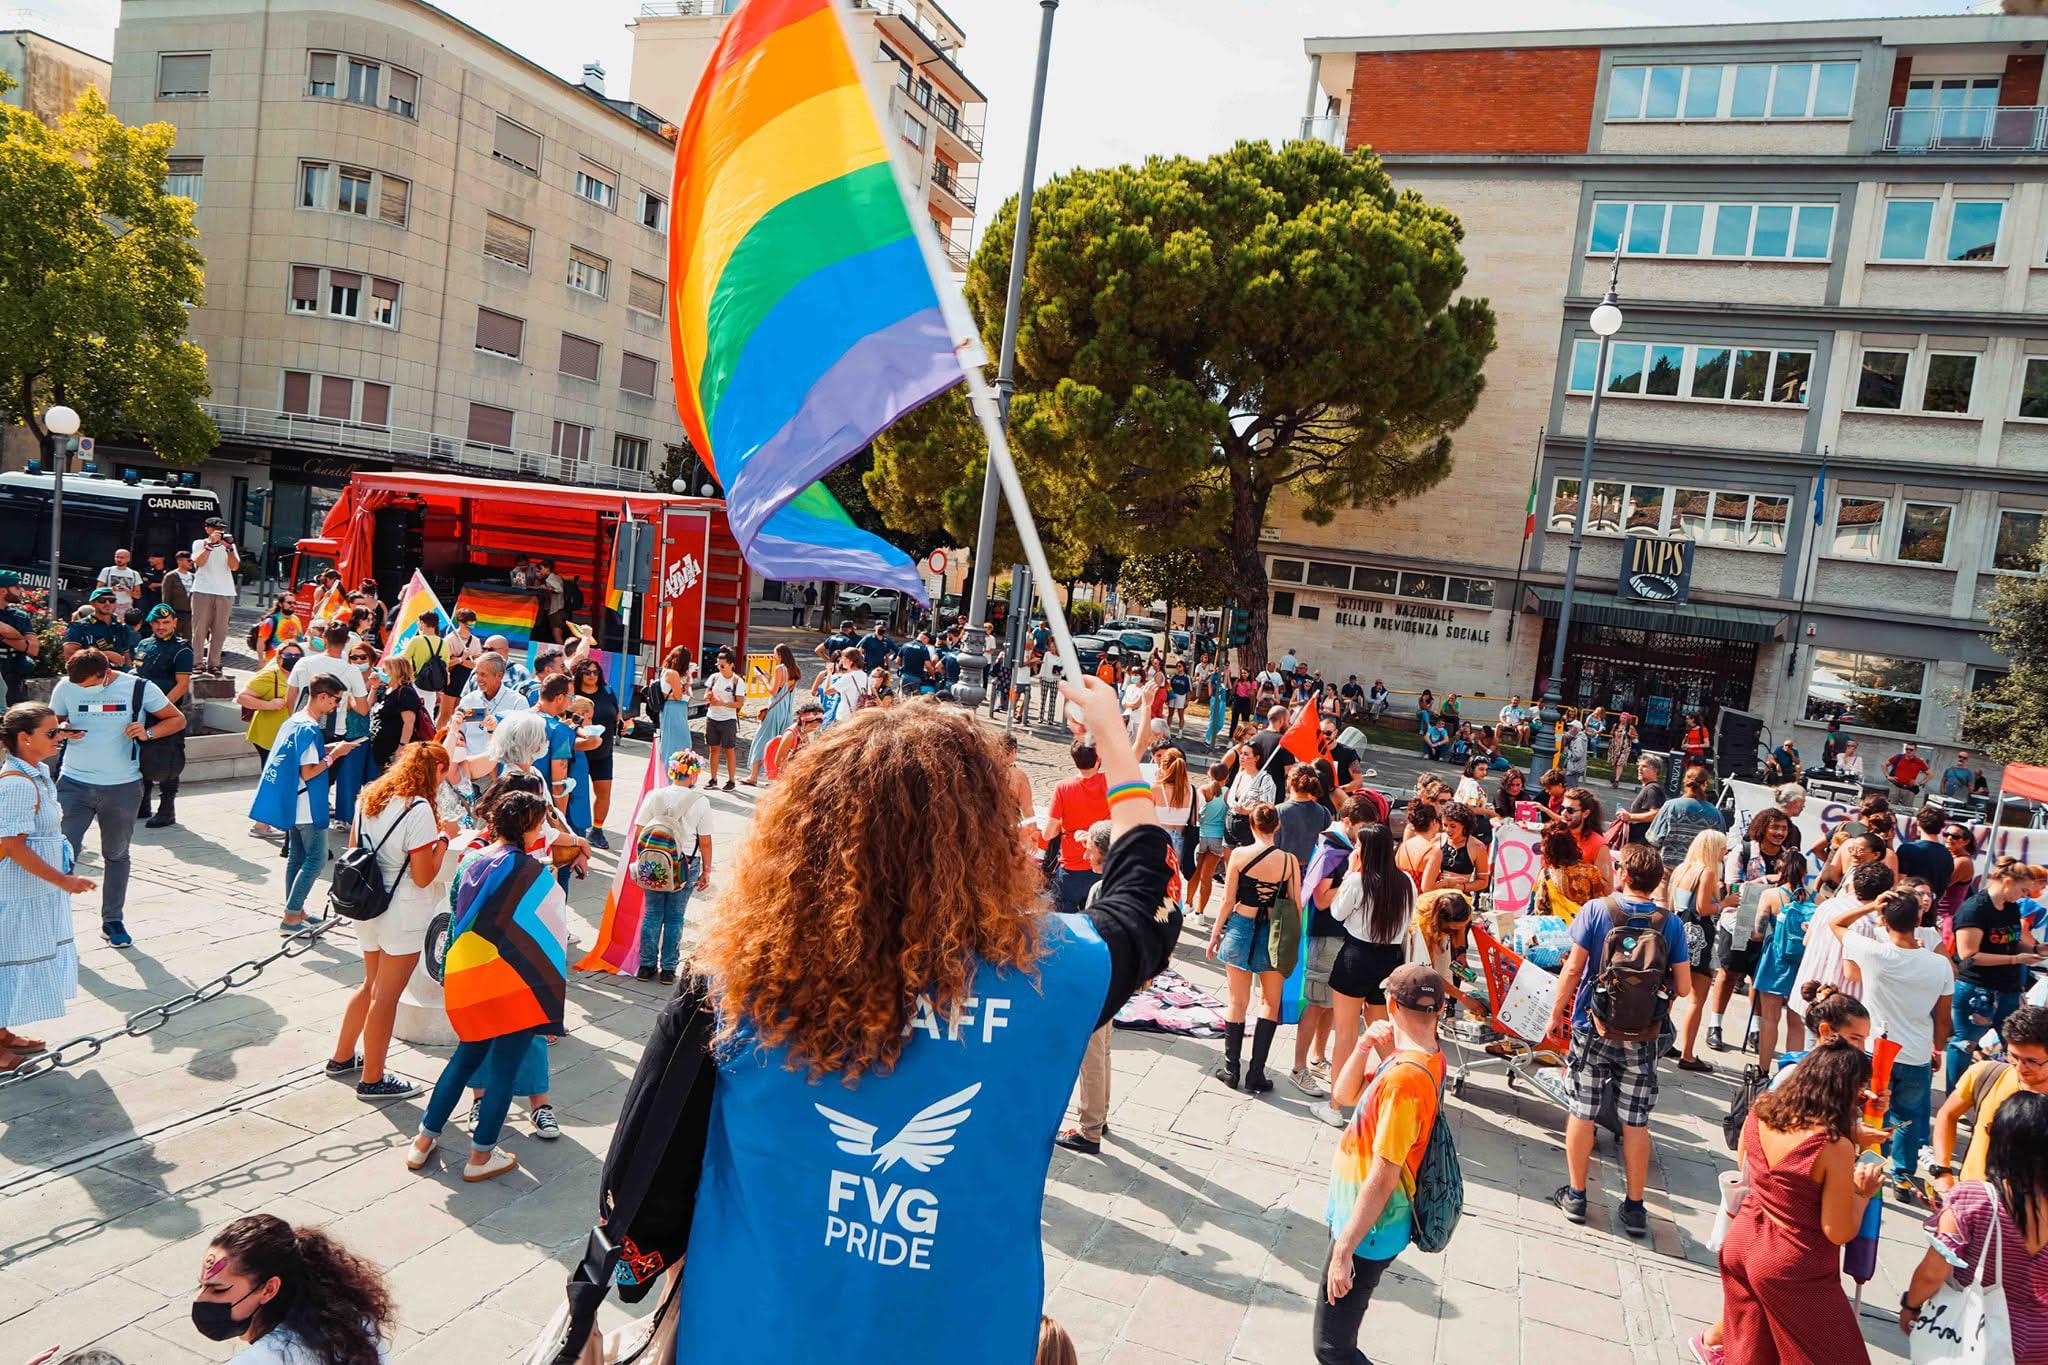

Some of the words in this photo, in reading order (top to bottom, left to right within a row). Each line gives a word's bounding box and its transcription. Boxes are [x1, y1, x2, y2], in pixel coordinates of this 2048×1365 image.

[148, 497, 214, 511] CARABINIERI
[1631, 538, 1685, 576] INPS
[1336, 597, 1383, 614] ISTITUTO
[1394, 603, 1455, 622] NAZIONALE
[1335, 612, 1367, 627] DELLA
[1373, 617, 1438, 636] PREVIDENZA
[1446, 626, 1490, 643] SOCIALE
[828, 1169, 939, 1234] FVG
[824, 1215, 935, 1270] PRIDE
